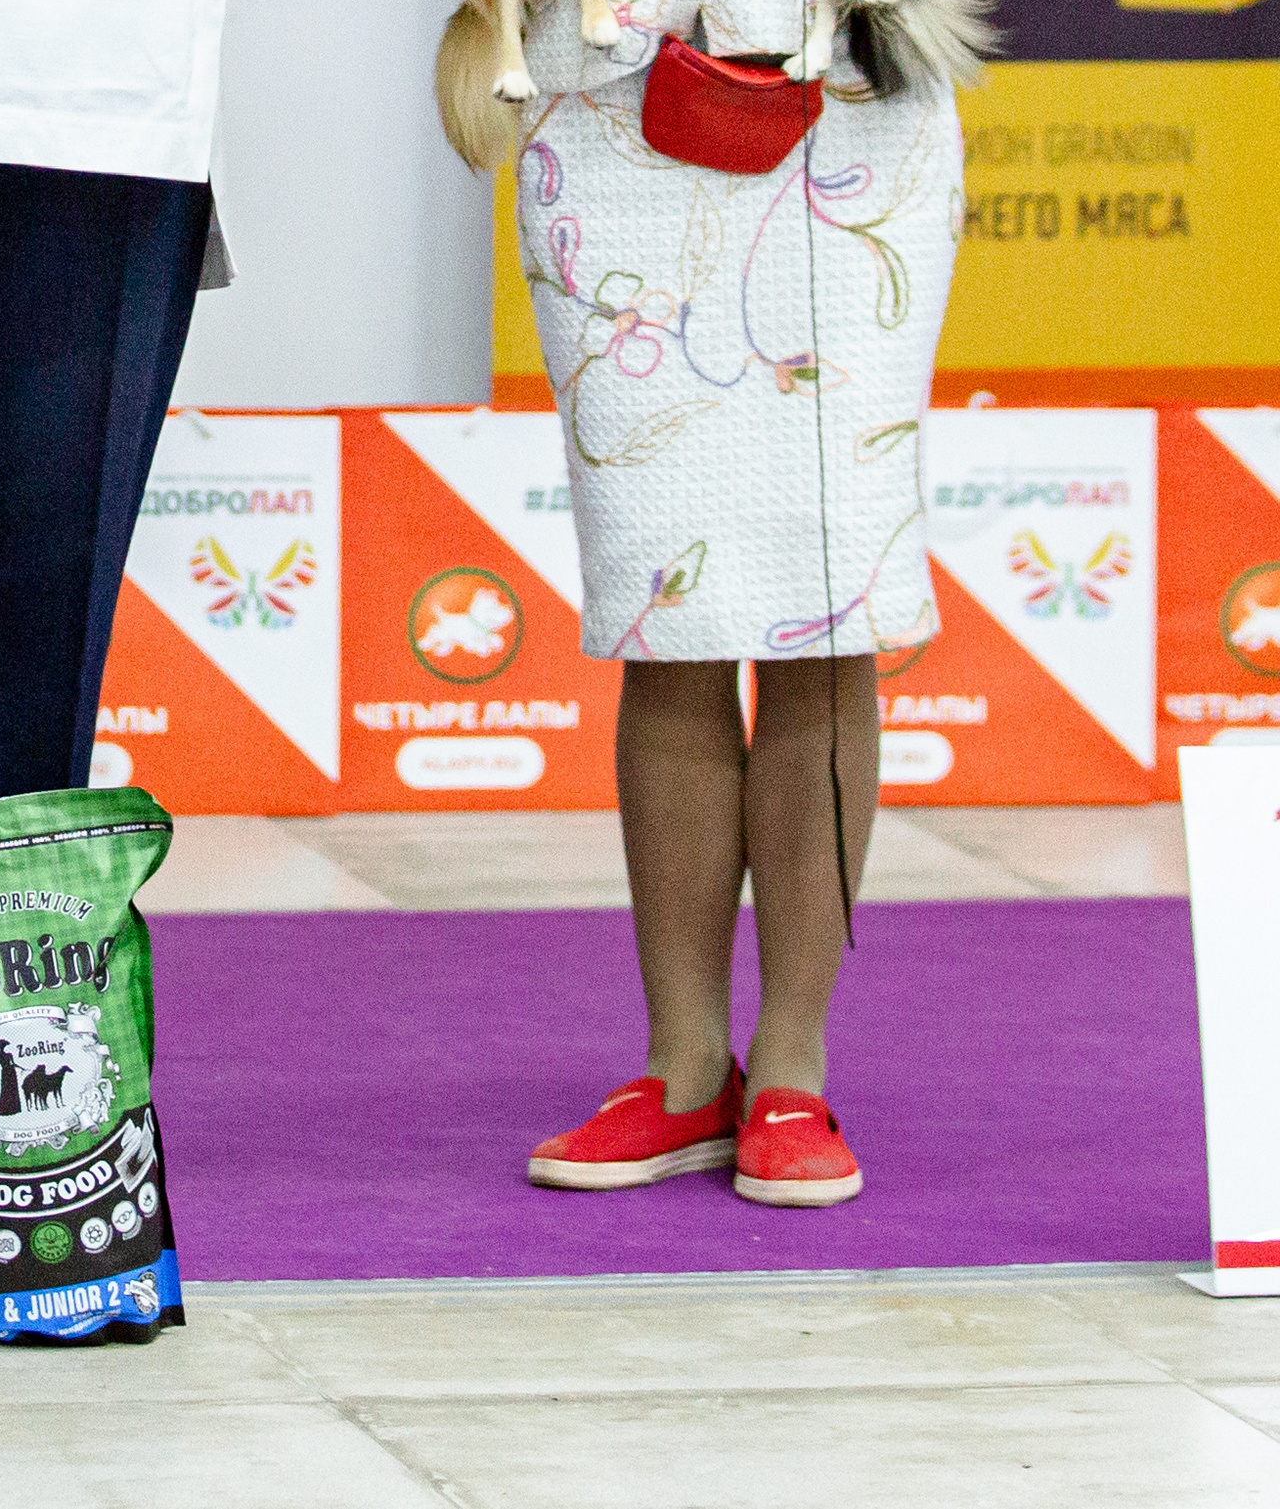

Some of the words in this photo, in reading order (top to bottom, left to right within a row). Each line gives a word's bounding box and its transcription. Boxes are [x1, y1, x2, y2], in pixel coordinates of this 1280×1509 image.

[1044, 124, 1194, 166] GRANDIN
[1075, 192, 1192, 240] МЯСА
[354, 700, 477, 730] ЧЕТЫРЕ
[483, 700, 579, 729] ЛАПЫ
[892, 695, 988, 724] ЛАПЫ
[12, 1007, 52, 1018] QUALITY
[16, 1040, 66, 1059] ZooRing
[13, 1131, 33, 1139] DOG
[36, 1124, 61, 1137] FOOD
[40, 1160, 113, 1205] FOOD
[4, 1297, 20, 1323] &
[26, 1285, 102, 1321] JUNIOR
[107, 1282, 122, 1307] 2
